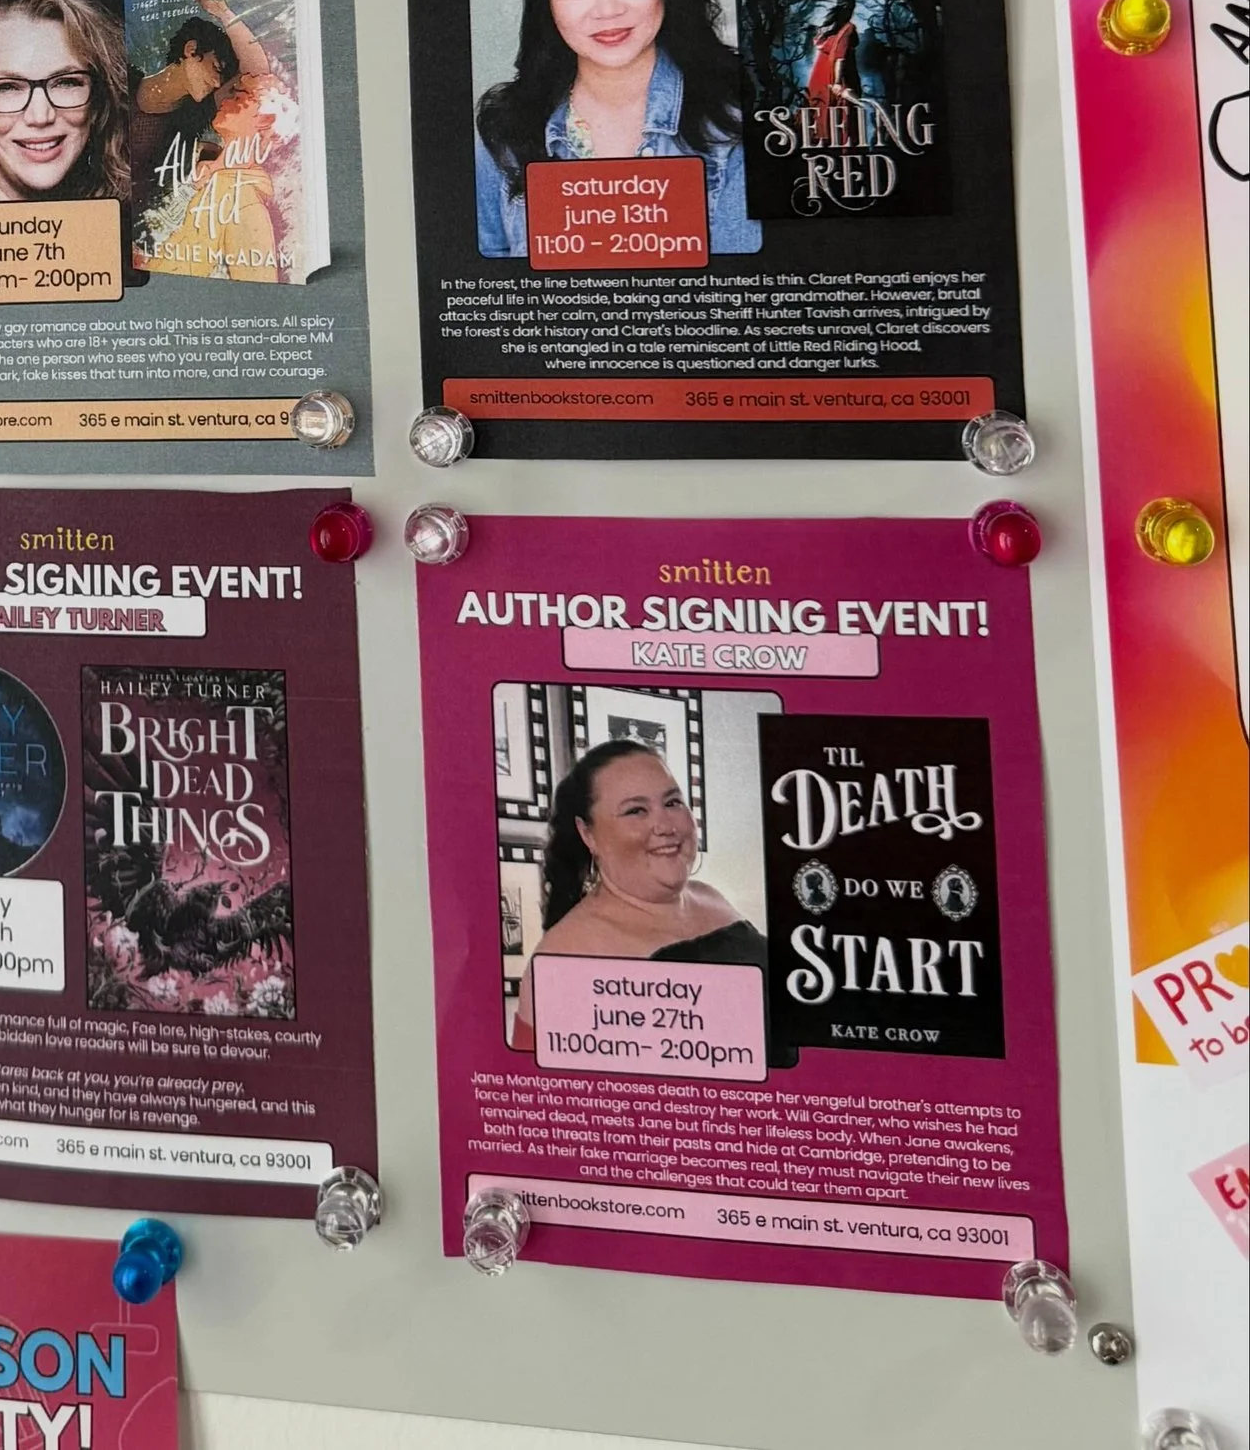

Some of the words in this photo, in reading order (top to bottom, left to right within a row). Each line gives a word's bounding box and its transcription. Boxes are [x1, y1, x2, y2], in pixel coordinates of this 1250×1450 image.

[755, 102, 935, 158] SEEING
[562, 175, 669, 201] saturday
[791, 154, 897, 217] RED
[563, 205, 616, 231] june
[622, 203, 668, 225] 13th
[29, 242, 65, 263] 7th
[34, 268, 111, 291] 2:00pm
[470, 389, 654, 406] smittenbookstore.com
[685, 391, 716, 408] 365
[722, 394, 733, 406] e
[740, 391, 785, 408] main
[790, 391, 809, 407] st.
[813, 391, 886, 409] ventura,
[891, 391, 915, 408] ca
[920, 389, 970, 407] 93001
[68, 606, 166, 633] TURNER
[631, 640, 706, 669] KATE
[713, 643, 807, 672] CROW
[152, 761, 253, 801] DEAD
[786, 924, 983, 1005] START
[579, 1164, 606, 1180] and
[611, 1164, 634, 1183] the
[636, 1166, 711, 1188] challenges
[716, 1174, 743, 1191] that
[748, 1177, 787, 1195] could
[792, 1180, 819, 1195] tear
[823, 1182, 861, 1200] them
[865, 1185, 910, 1202] apart.
